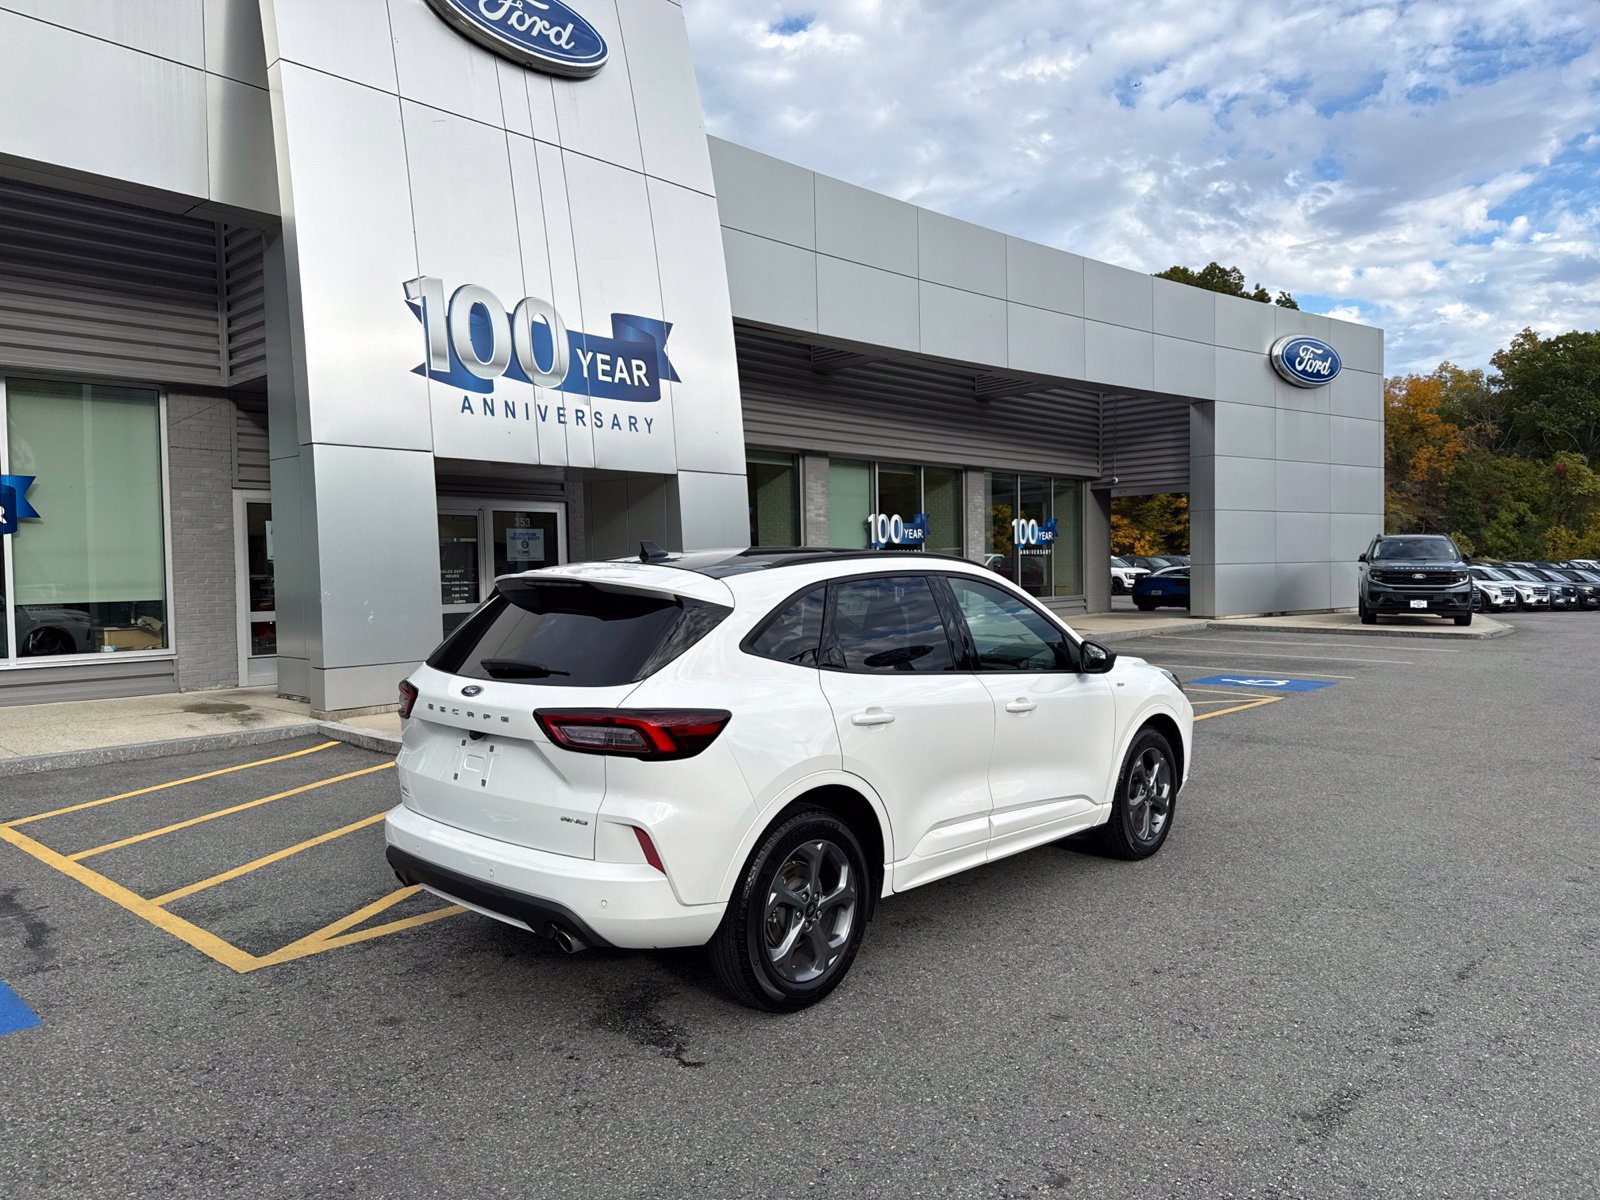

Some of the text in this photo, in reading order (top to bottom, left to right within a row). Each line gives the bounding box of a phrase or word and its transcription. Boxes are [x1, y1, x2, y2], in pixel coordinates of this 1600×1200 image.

[402, 275, 650, 388] 100 YEAR
[1295, 345, 1331, 375] Ford
[460, 395, 654, 434] ANNIVERSARY
[513, 517, 531, 528] 353
[867, 513, 924, 544] 100 YEAR
[1011, 518, 1054, 545] 100 YEAR
